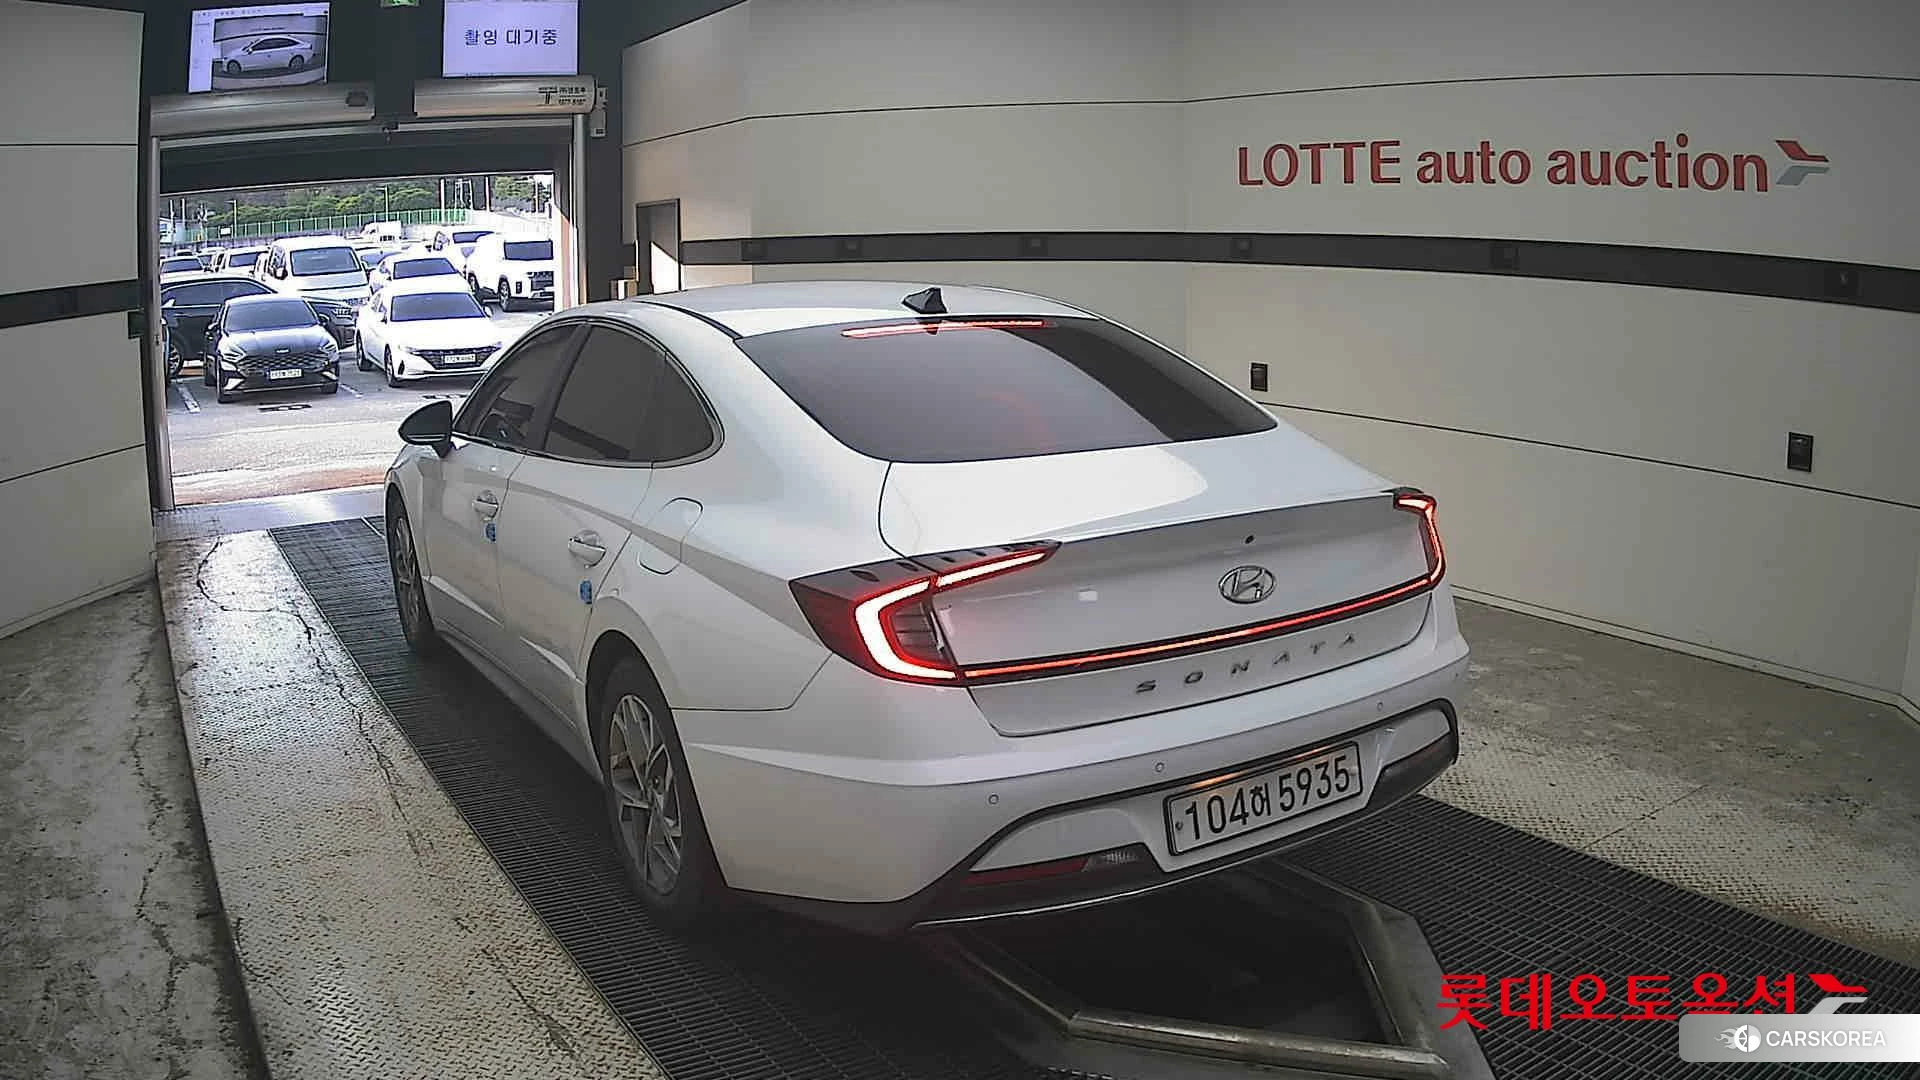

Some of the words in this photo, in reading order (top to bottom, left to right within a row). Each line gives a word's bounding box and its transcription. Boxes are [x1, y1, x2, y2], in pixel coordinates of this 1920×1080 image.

[506, 29, 556, 45] 대기중
[1238, 140, 1401, 186] LOTTE
[1416, 140, 1531, 185] auto
[1546, 133, 1768, 192] auction
[1136, 635, 1355, 693] SONATA
